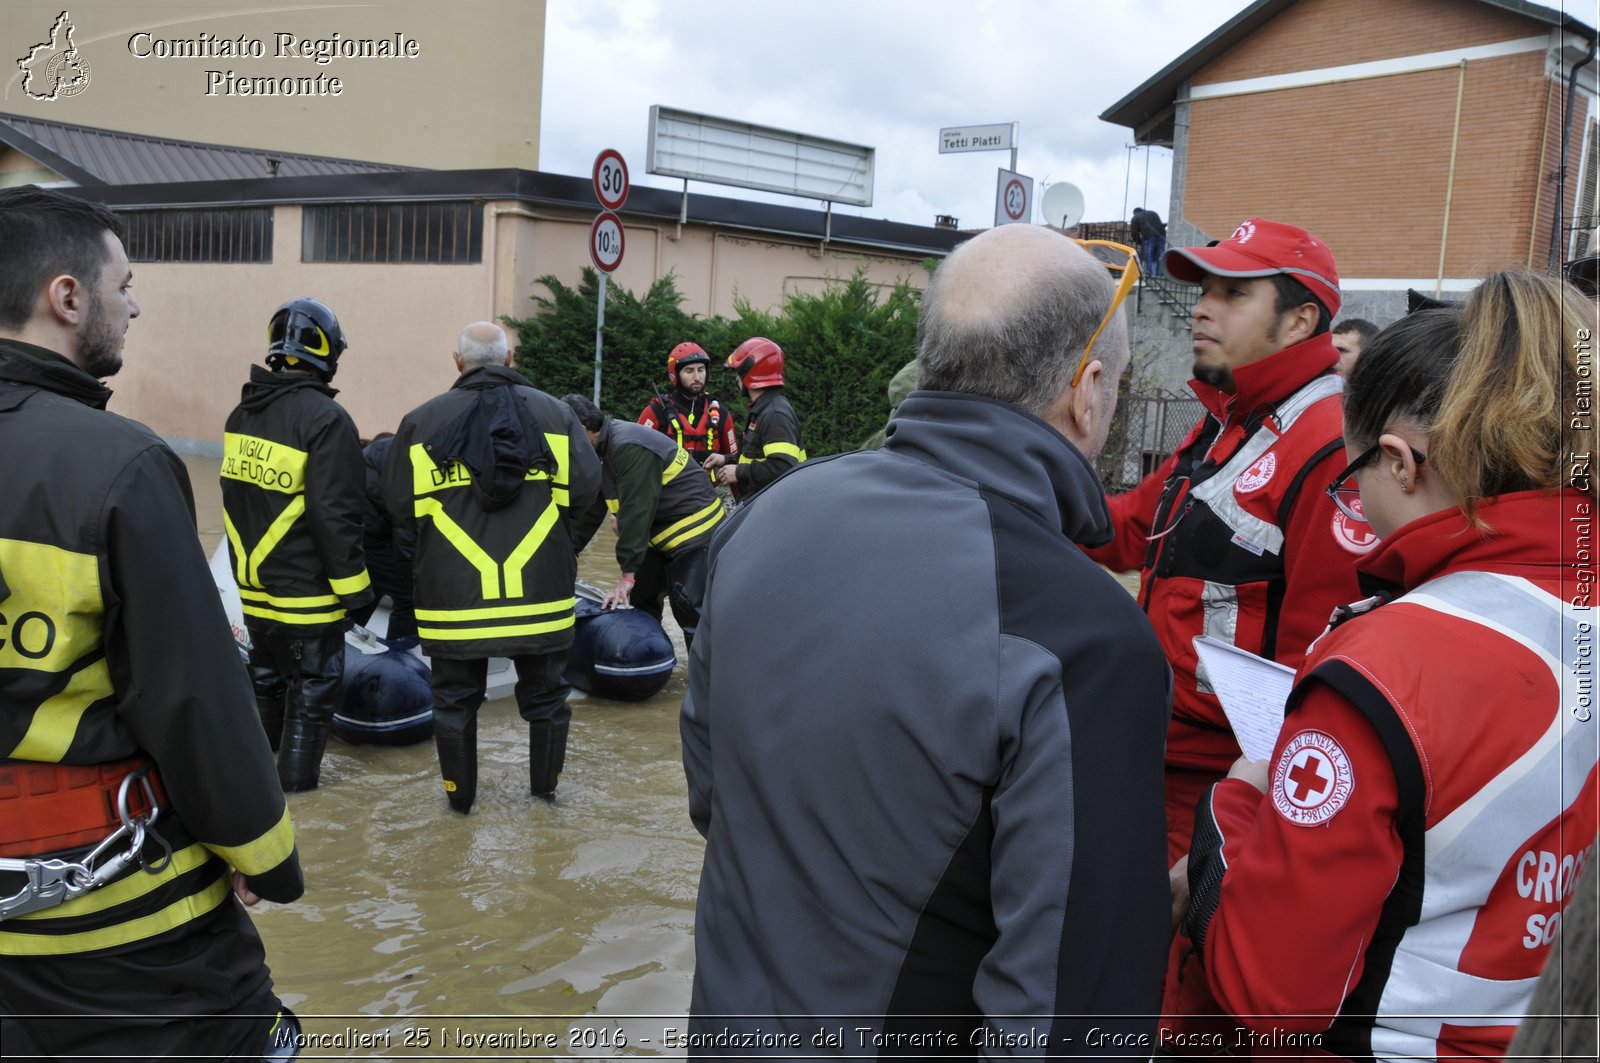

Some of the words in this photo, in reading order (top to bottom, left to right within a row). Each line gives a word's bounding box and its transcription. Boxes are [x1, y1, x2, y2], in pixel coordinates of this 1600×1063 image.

[943, 138, 968, 149] Tetti
[972, 135, 1001, 147] Piatti
[602, 164, 622, 195] 30
[1294, 736, 1304, 751] DI
[1304, 731, 1342, 763] GINEVRA
[1337, 763, 1349, 777] 22
[1273, 745, 1294, 814] CONVENZIONE
[1301, 808, 1323, 823] 1864
